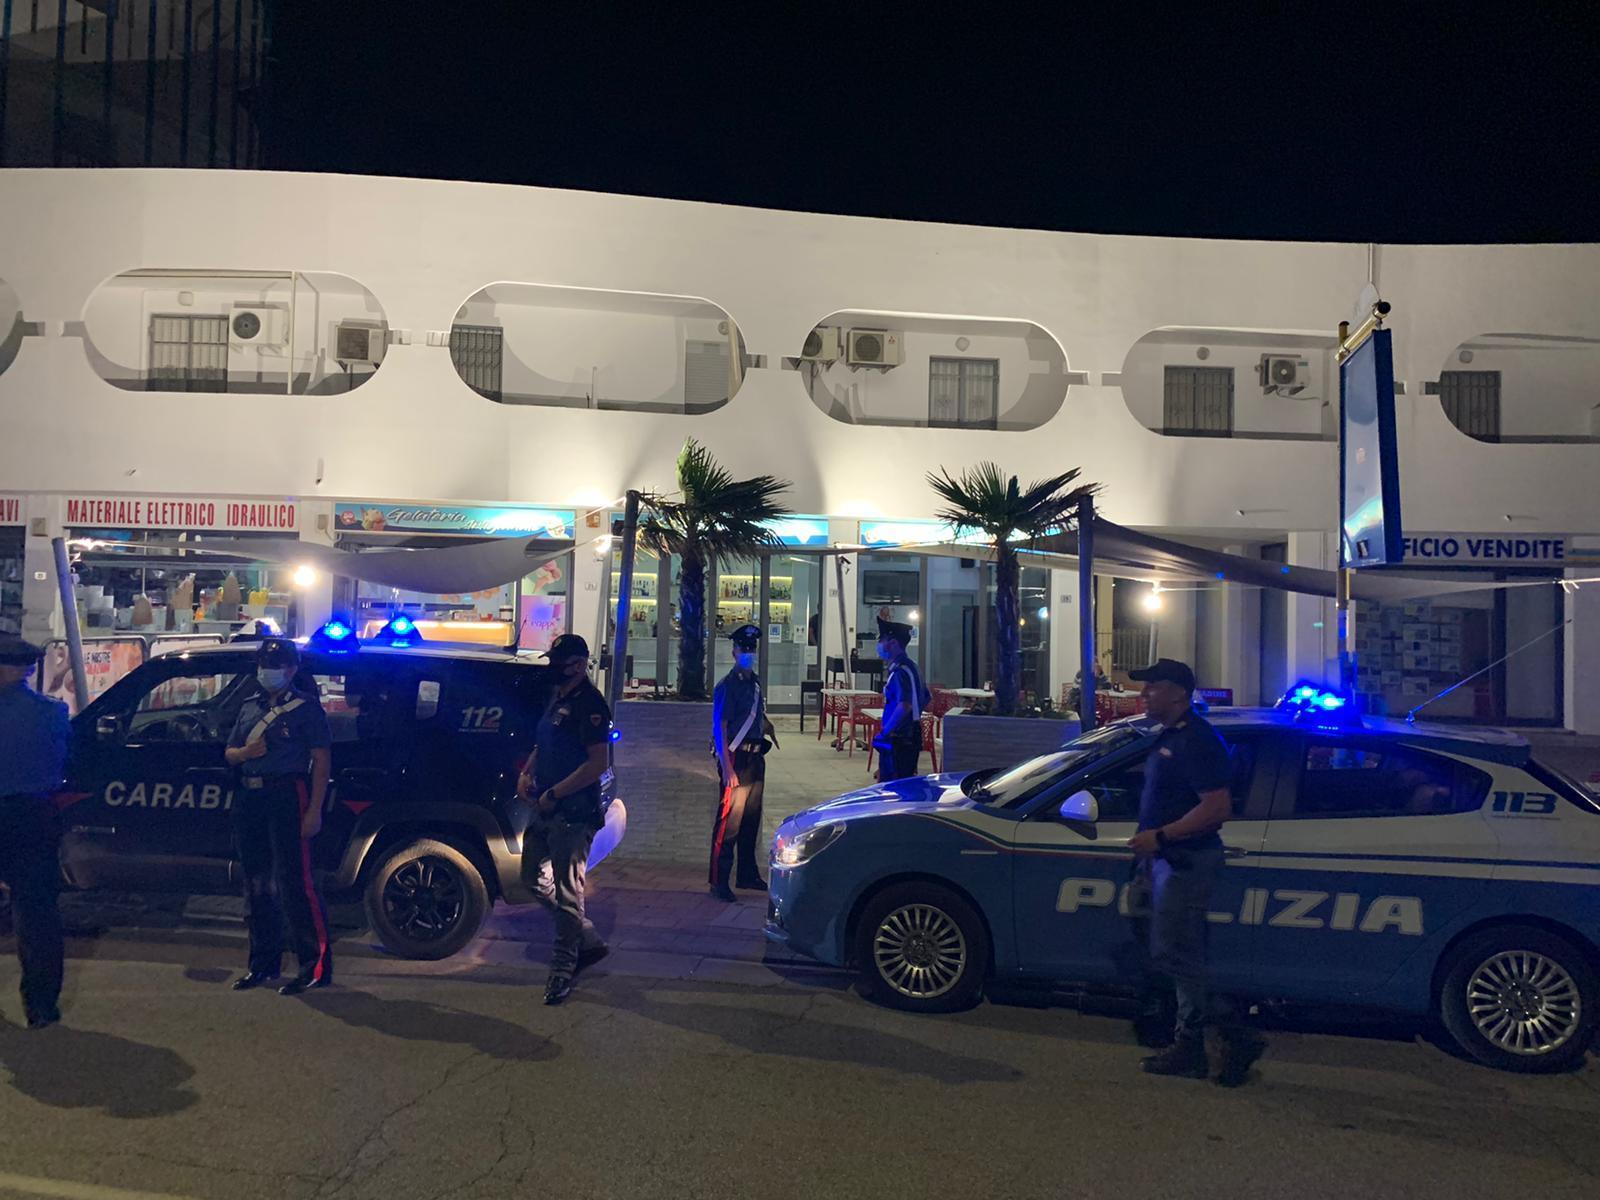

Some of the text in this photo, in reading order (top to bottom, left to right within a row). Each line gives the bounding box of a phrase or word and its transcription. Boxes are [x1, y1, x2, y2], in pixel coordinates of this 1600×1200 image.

[67, 499, 295, 528] MATERIALE ELETTRICO IDRAULICO
[1466, 539, 1564, 559] VENDITE
[461, 706, 503, 727] 112
[1492, 791, 1558, 814] 113
[1055, 877, 1425, 936] PIZIA
